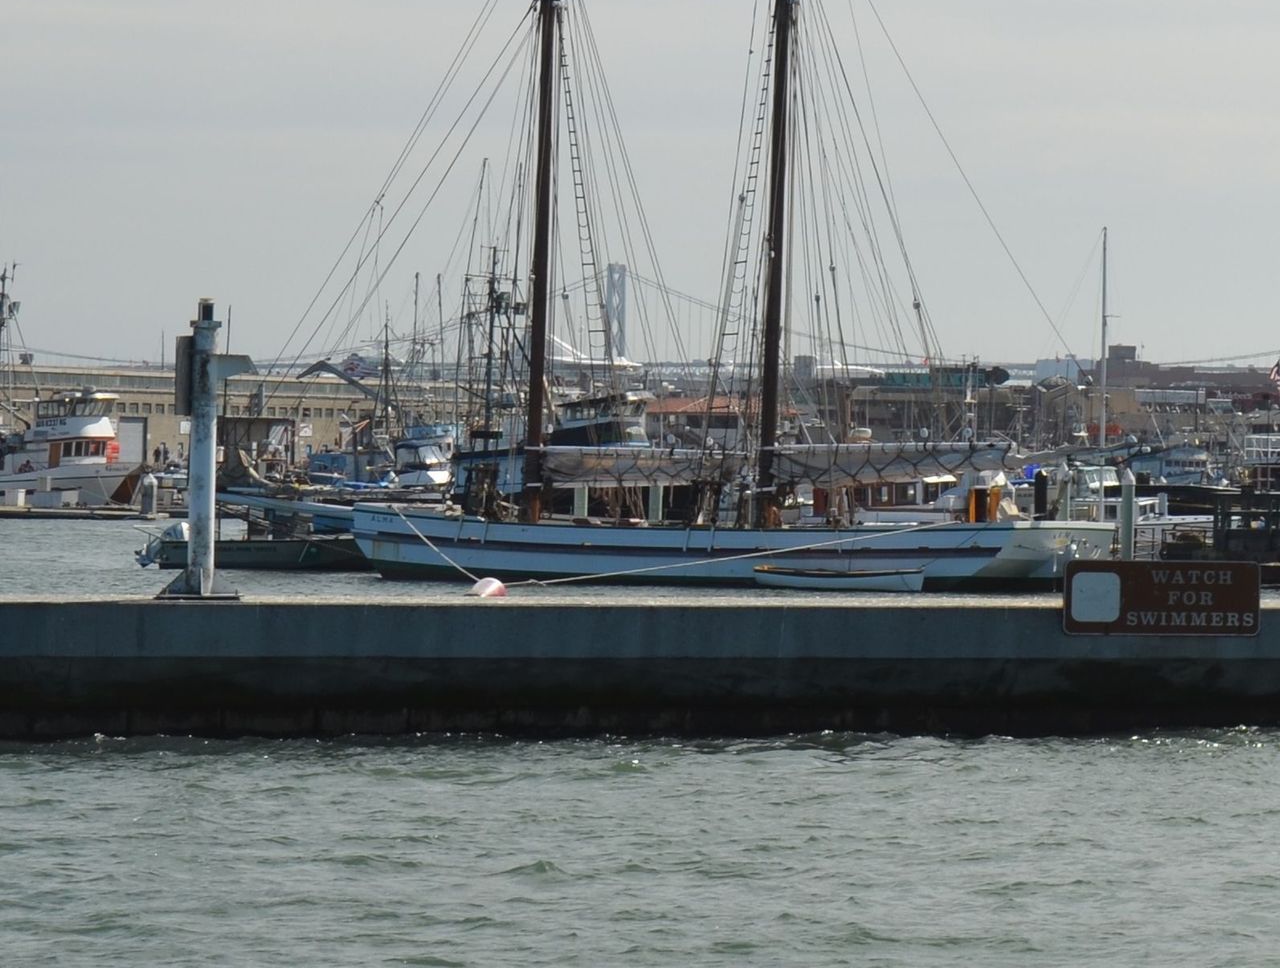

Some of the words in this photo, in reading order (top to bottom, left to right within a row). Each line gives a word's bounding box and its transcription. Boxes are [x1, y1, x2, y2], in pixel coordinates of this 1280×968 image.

[1151, 570, 1233, 585] WATCH
[1167, 591, 1214, 606] FOR
[1126, 611, 1254, 626] SWIMMERS
